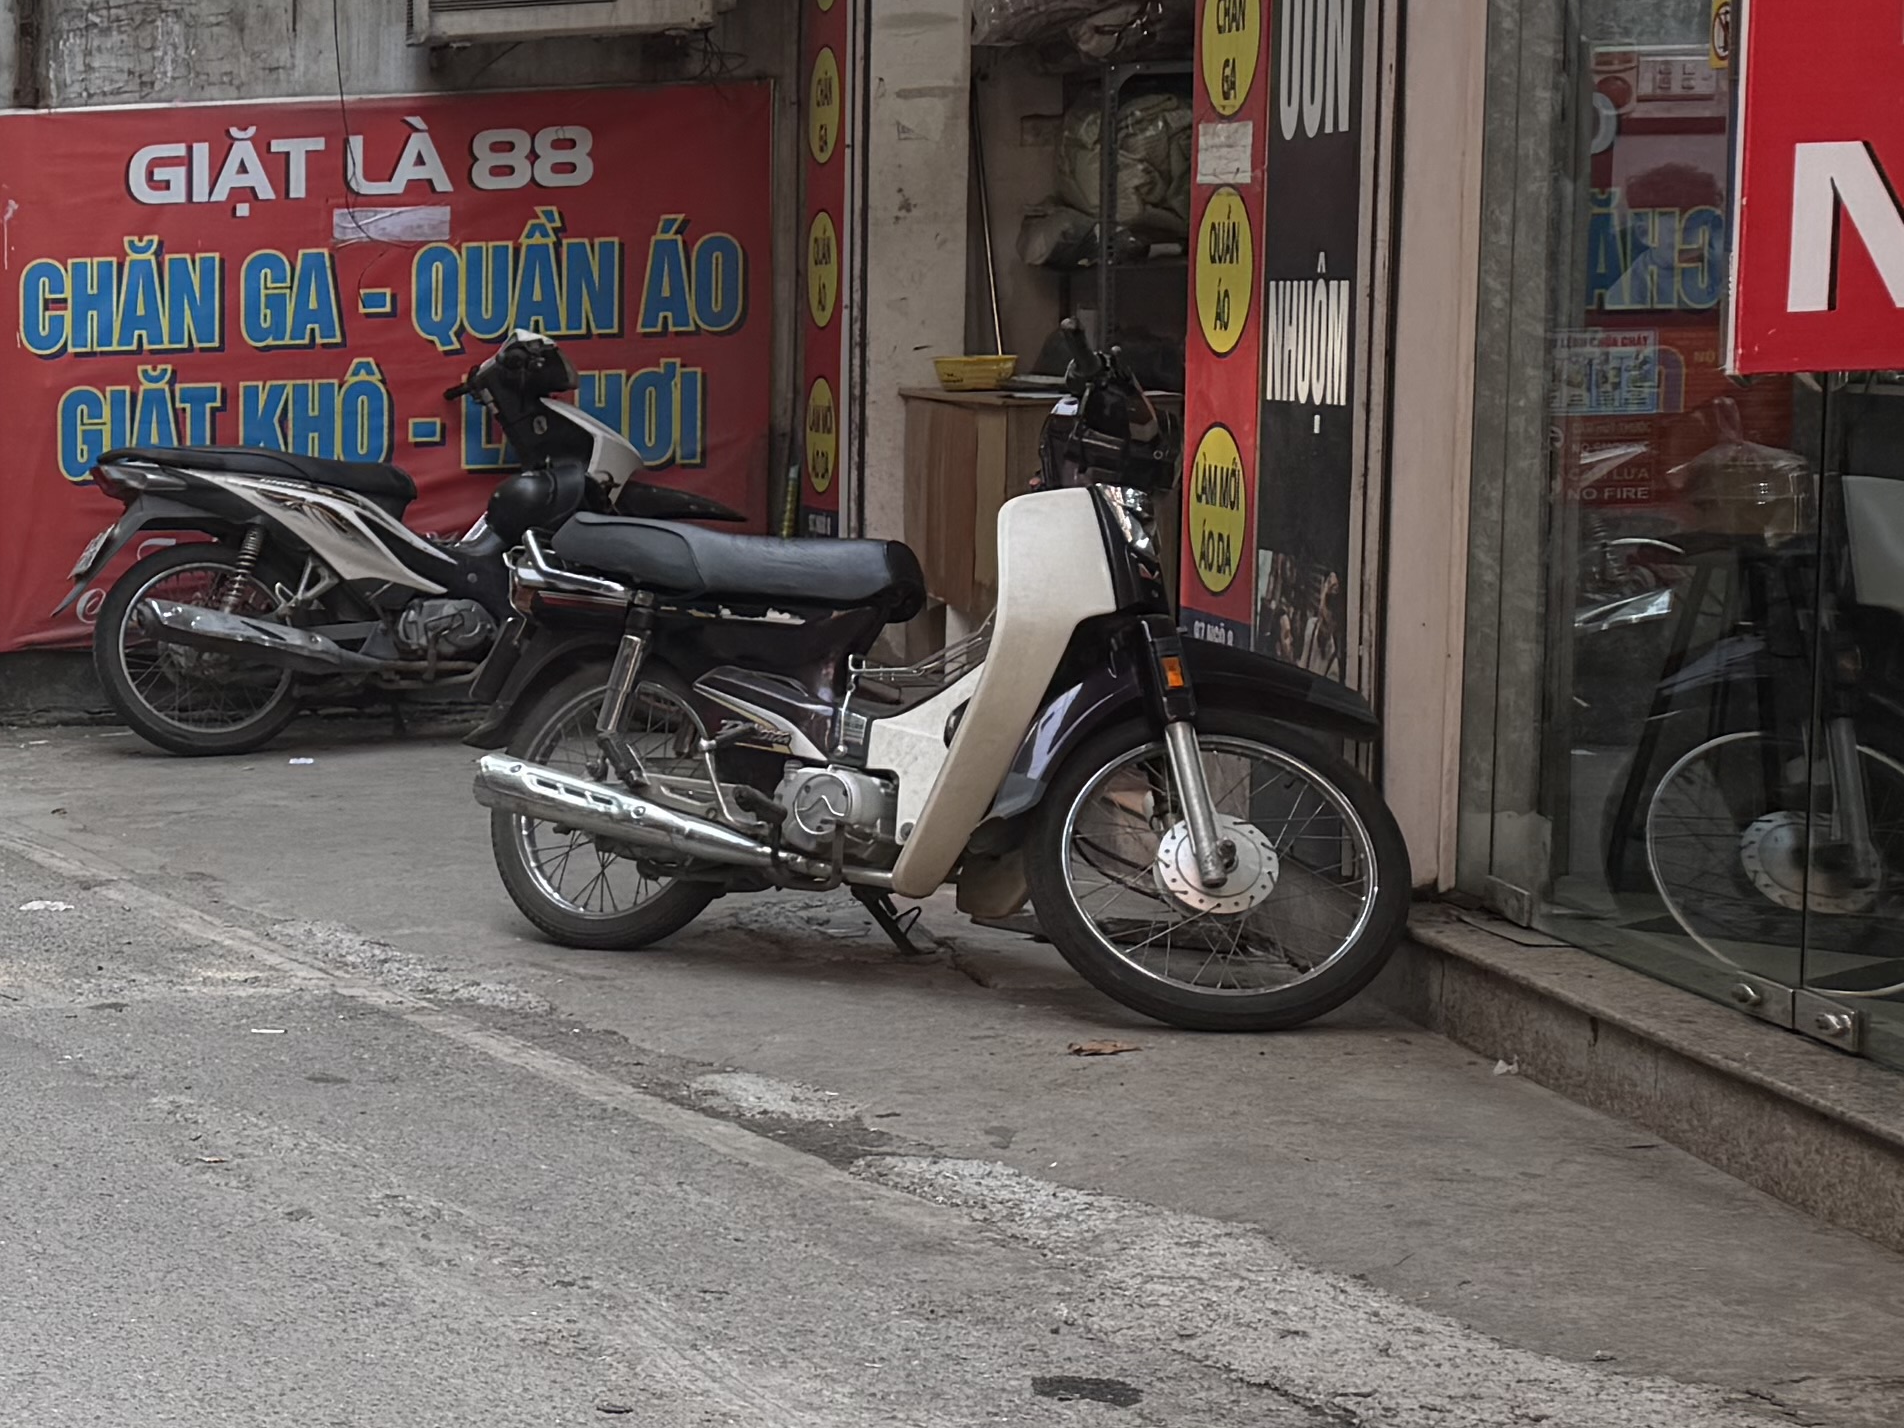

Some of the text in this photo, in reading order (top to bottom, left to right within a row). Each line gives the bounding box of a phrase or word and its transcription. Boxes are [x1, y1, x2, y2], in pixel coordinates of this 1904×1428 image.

[1221, 59, 1237, 102] GA
[129, 115, 594, 218] GIẶT LÀ 88
[17, 205, 746, 356] CHĂN GA QUẦN ÁO
[1213, 288, 1231, 332] ÁO
[1266, 251, 1349, 435] NHUỘM
[238, 356, 390, 467] KHÔ
[576, 358, 702, 465] HƠI
[1195, 452, 1217, 511] LÀM
[1604, 486, 1649, 500] FIRE
[1199, 525, 1233, 576] ÁO DA
